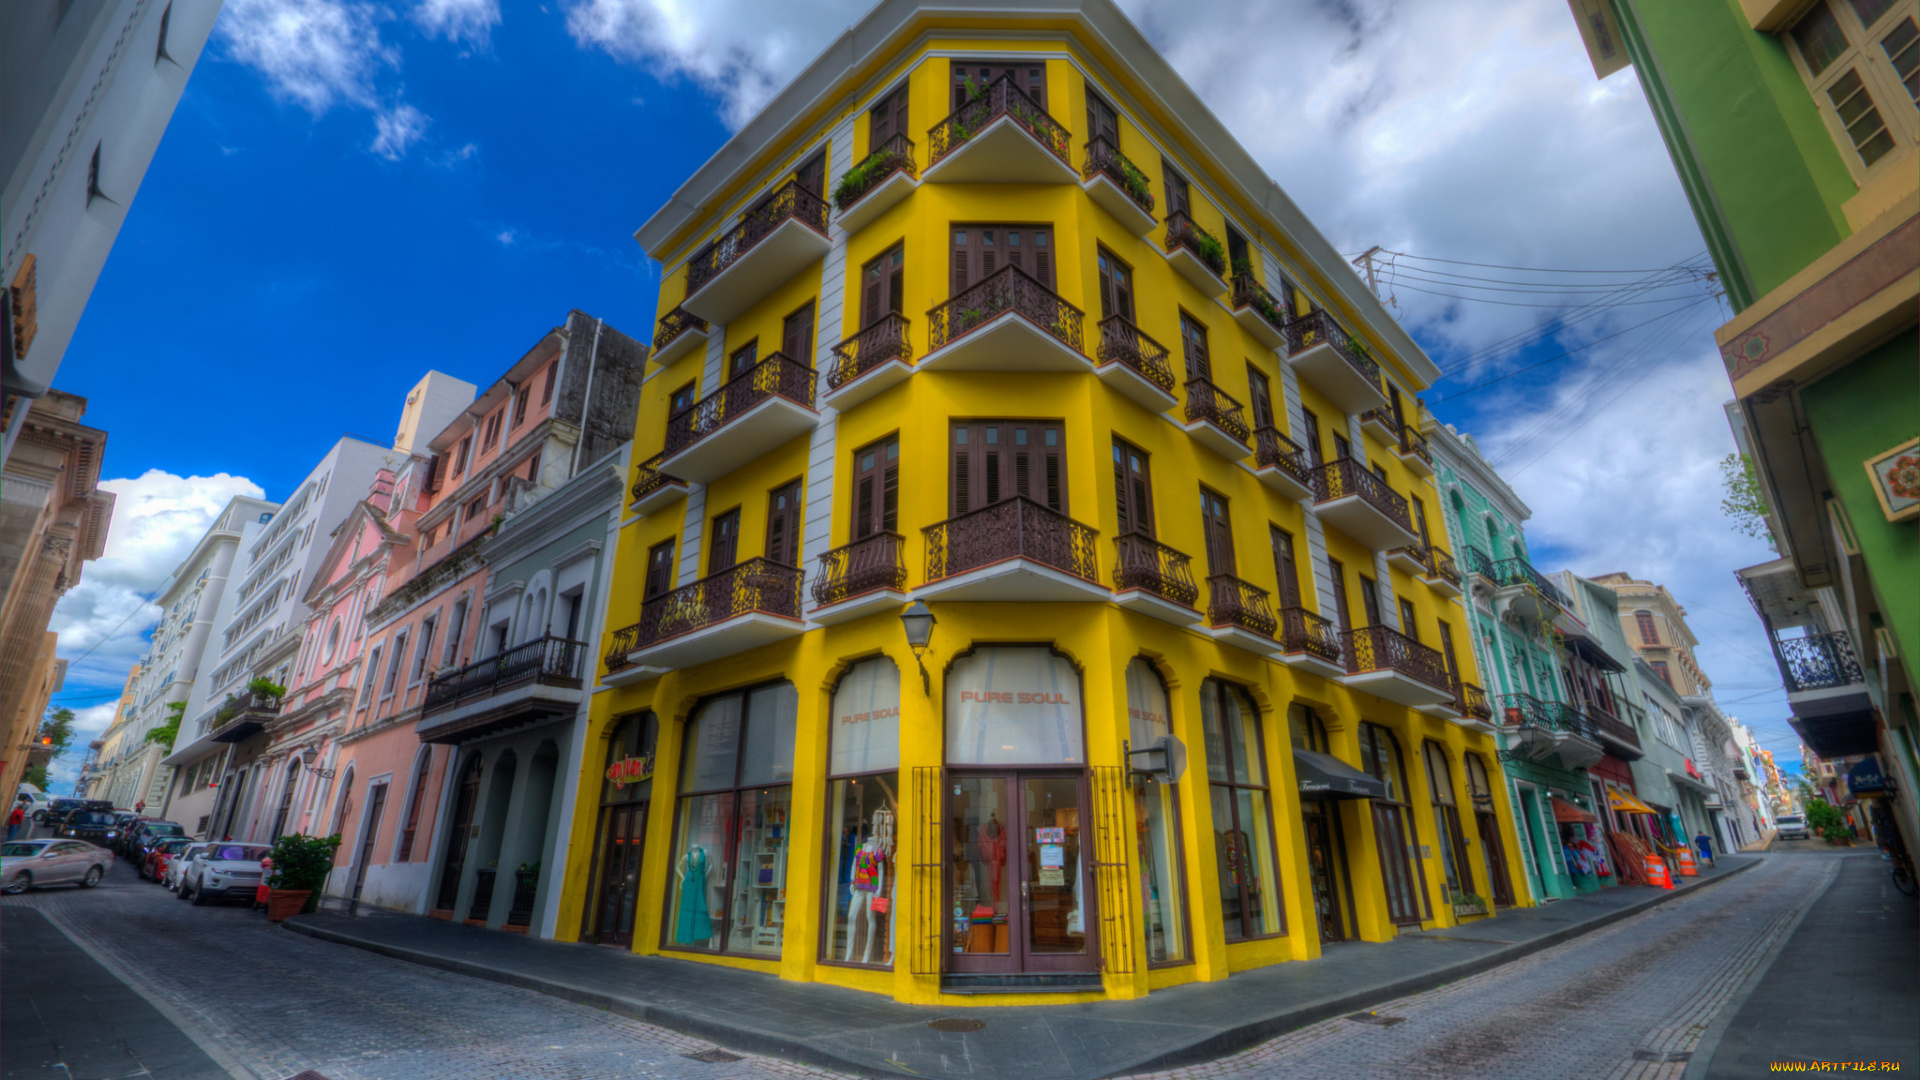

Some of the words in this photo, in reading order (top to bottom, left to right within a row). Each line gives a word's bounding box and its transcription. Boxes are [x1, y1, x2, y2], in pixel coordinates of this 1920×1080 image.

[961, 691, 1014, 703] PURE
[1017, 692, 1070, 704] SOUL
[841, 712, 870, 726] PURE
[872, 706, 900, 721] SOUL
[1141, 711, 1166, 725] SOUL
